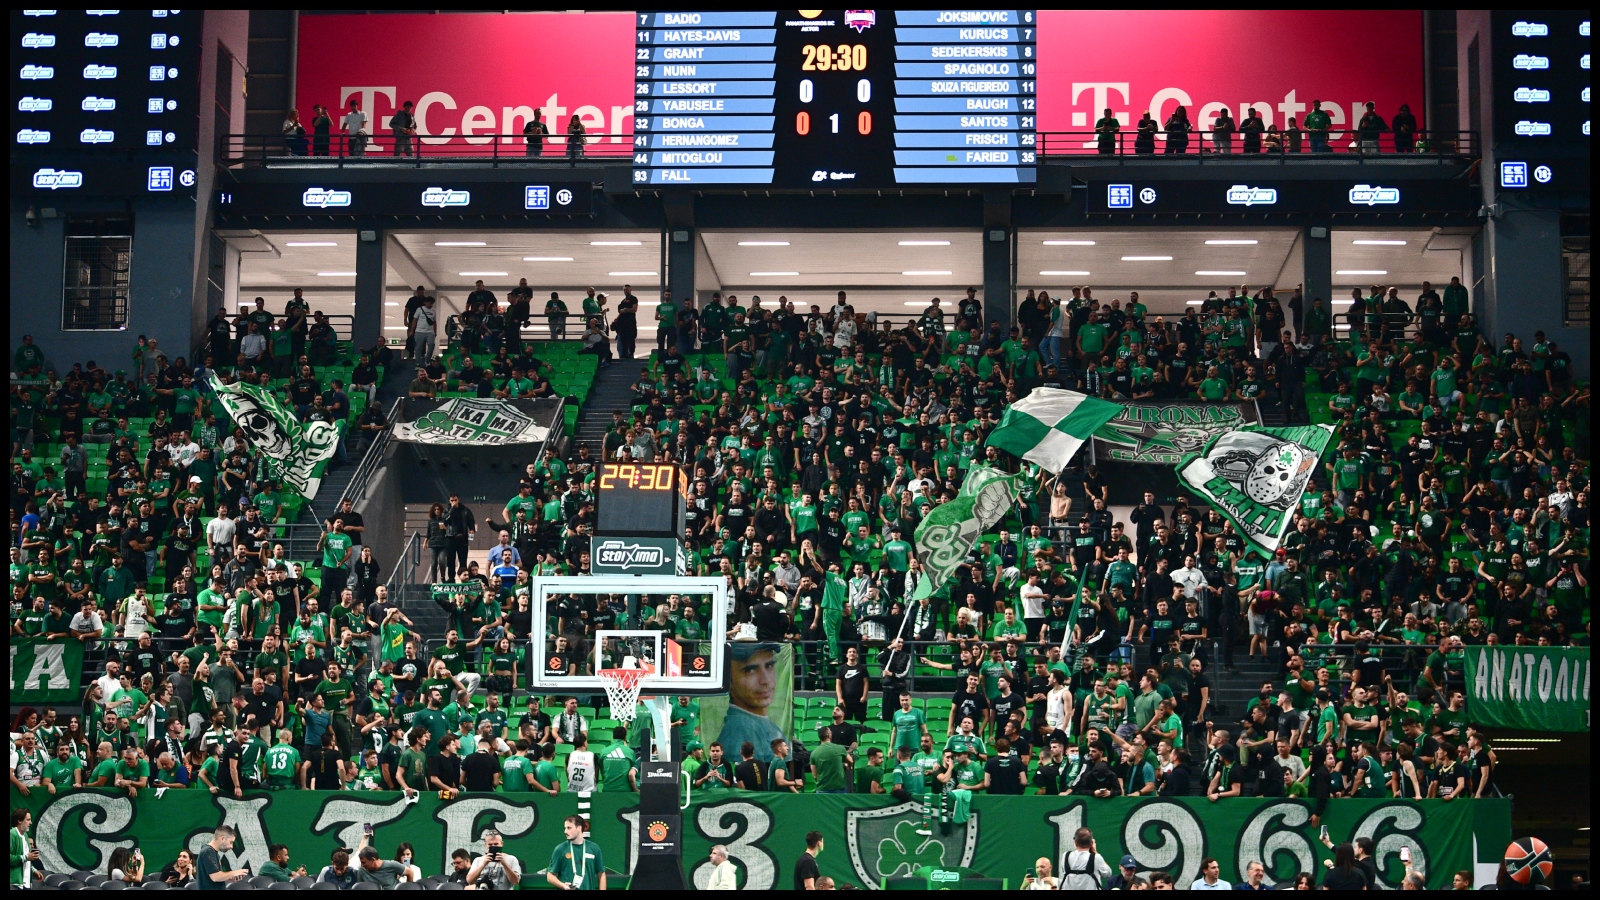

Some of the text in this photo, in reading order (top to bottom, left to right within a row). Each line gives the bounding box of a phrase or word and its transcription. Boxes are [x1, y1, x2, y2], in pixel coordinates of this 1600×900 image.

[640, 14, 648, 25] 7
[664, 13, 701, 25] BADIO
[936, 11, 1008, 22] JOKSIMOVIC
[1024, 11, 1032, 22] 6
[637, 31, 650, 42] 11
[664, 30, 741, 42] HAYES-DAVIS
[959, 29, 1008, 40] KURUCS
[1024, 29, 1032, 39] 7
[636, 48, 650, 59] 22
[663, 48, 704, 59] GRANT
[802, 44, 867, 71] 29:30
[931, 47, 1008, 57] SEDEKERSKIS
[1024, 47, 1032, 57] 8
[636, 66, 650, 77] 25
[663, 66, 696, 77] NUNN
[944, 64, 1009, 75] SPAGNOLO
[1022, 64, 1035, 75] 10
[636, 84, 649, 94] 26
[663, 83, 717, 94] LESSORT
[799, 79, 813, 103] 0
[857, 79, 871, 103] 0
[931, 82, 1009, 93] SOUZA FIGUEIREDO
[1022, 82, 1034, 92] 11
[636, 101, 648, 111] 28
[663, 101, 724, 111] YABUSELE
[966, 99, 1008, 109] BAUGH
[1022, 99, 1034, 109] 12
[414, 91, 634, 146] Center
[635, 119, 648, 129] 32
[662, 118, 704, 128] BONGA
[796, 111, 810, 135] 0
[829, 113, 838, 133] 1
[857, 111, 872, 135] 0
[960, 117, 1008, 127] SANTOS
[1022, 117, 1034, 127] 21
[635, 136, 647, 146] 41
[662, 135, 738, 145] HERNANGOMEZ
[965, 134, 1008, 144] FRISCH
[1022, 135, 1034, 144] 25
[634, 154, 647, 163] 44
[662, 153, 722, 163] MITOGLOU
[966, 152, 1008, 162] FARIED
[1022, 153, 1034, 162] 35
[634, 171, 647, 181] 93
[661, 171, 691, 180] FALL
[600, 464, 674, 490] 29:30
[271, 753, 288, 770] 13
[572, 767, 586, 782] 25
[36, 792, 537, 877] GATE
[1045, 801, 1428, 890] 1966
